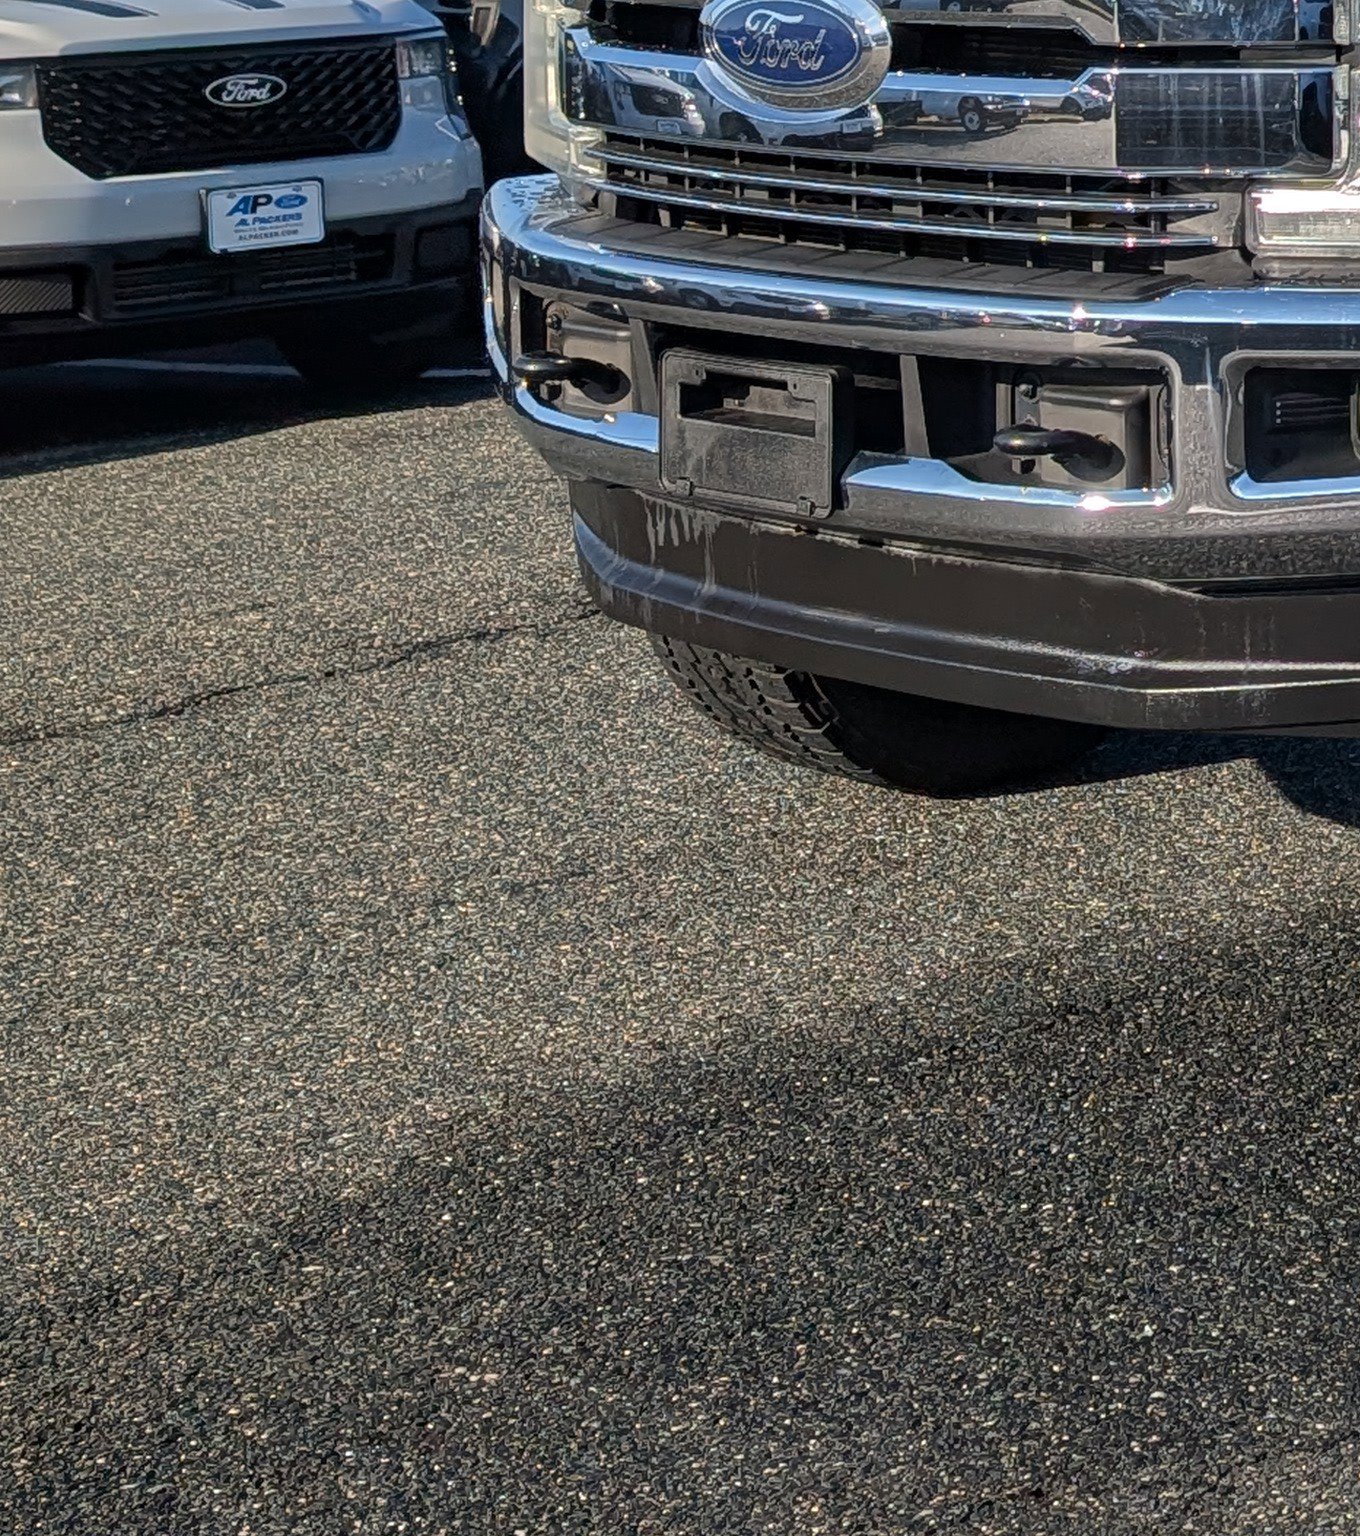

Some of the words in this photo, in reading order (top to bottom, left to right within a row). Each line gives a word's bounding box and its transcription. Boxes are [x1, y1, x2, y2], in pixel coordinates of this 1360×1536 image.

[738, 8, 828, 71] Ford
[222, 79, 271, 101] Ford
[227, 194, 272, 215] AP
